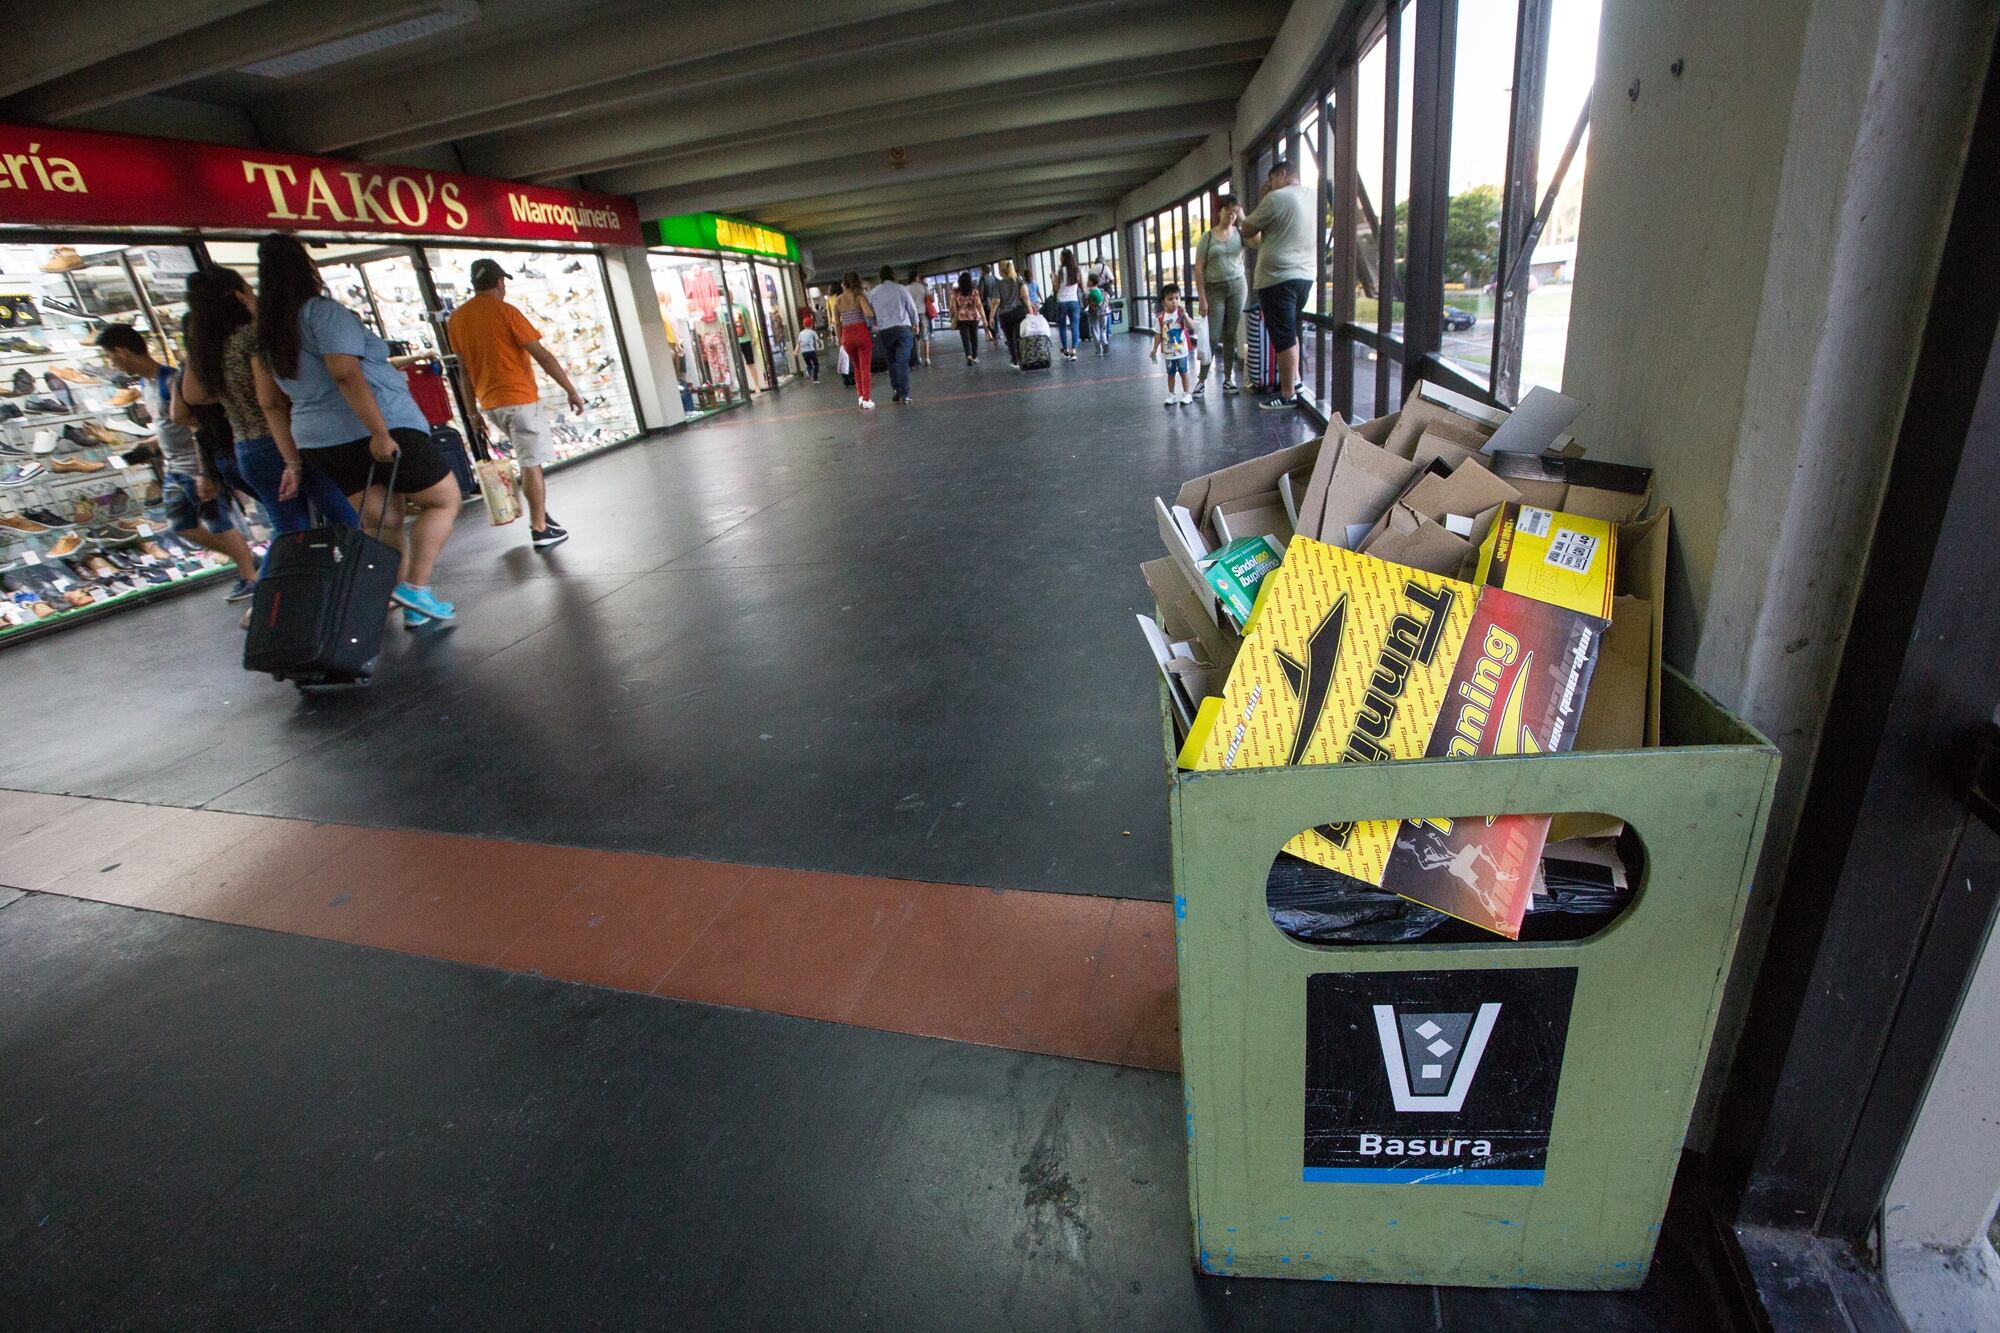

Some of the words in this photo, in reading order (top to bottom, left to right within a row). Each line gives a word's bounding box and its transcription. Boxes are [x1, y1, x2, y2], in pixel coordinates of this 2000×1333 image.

[241, 160, 468, 231] TAKO'S
[508, 192, 620, 233] Marroquinería
[1548, 716, 1565, 752] new
[1560, 627, 1593, 717] generation
[1359, 1133, 1492, 1157] Basura
